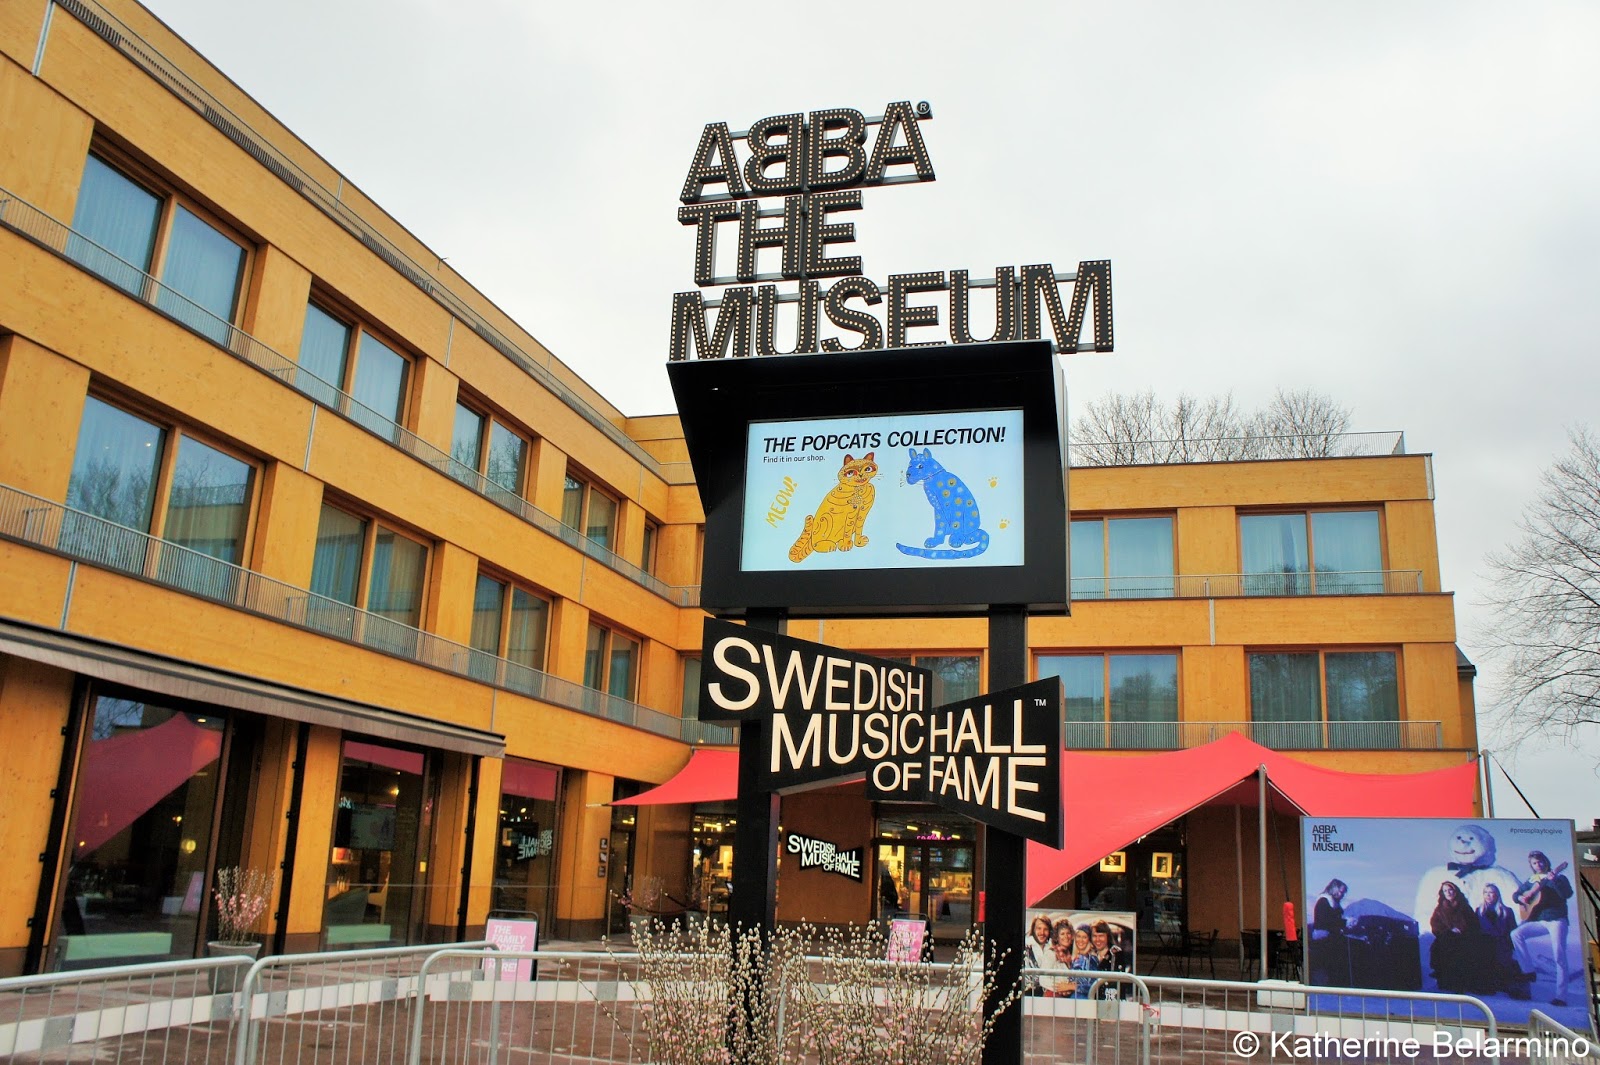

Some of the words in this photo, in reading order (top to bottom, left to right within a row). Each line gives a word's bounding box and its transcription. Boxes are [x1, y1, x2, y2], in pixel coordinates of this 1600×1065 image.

[680, 100, 936, 205] ABBA
[677, 189, 864, 286] THE
[668, 259, 1115, 362] MUSEUM
[763, 436, 796, 453] THE
[801, 432, 881, 451] POPCATS
[887, 426, 1006, 448] COLLECTION!
[807, 454, 825, 463] shop.
[765, 475, 798, 529] MEOW!
[707, 636, 924, 712] SWEDISH
[770, 712, 925, 773] MUSIC
[930, 698, 1047, 754] HALL
[872, 761, 922, 792] OF
[929, 755, 1047, 823] FAME
[1312, 824, 1338, 834] ABBA
[1312, 833, 1331, 843] THE
[787, 834, 836, 854] SWEDISH
[1312, 842, 1354, 852] MUSEUM
[801, 852, 835, 867] MUSIC
[835, 850, 860, 864] HALL
[823, 863, 835, 872] OF
[834, 862, 860, 878] FAME
[491, 934, 527, 946] FAMILY
[494, 925, 512, 935] THE
